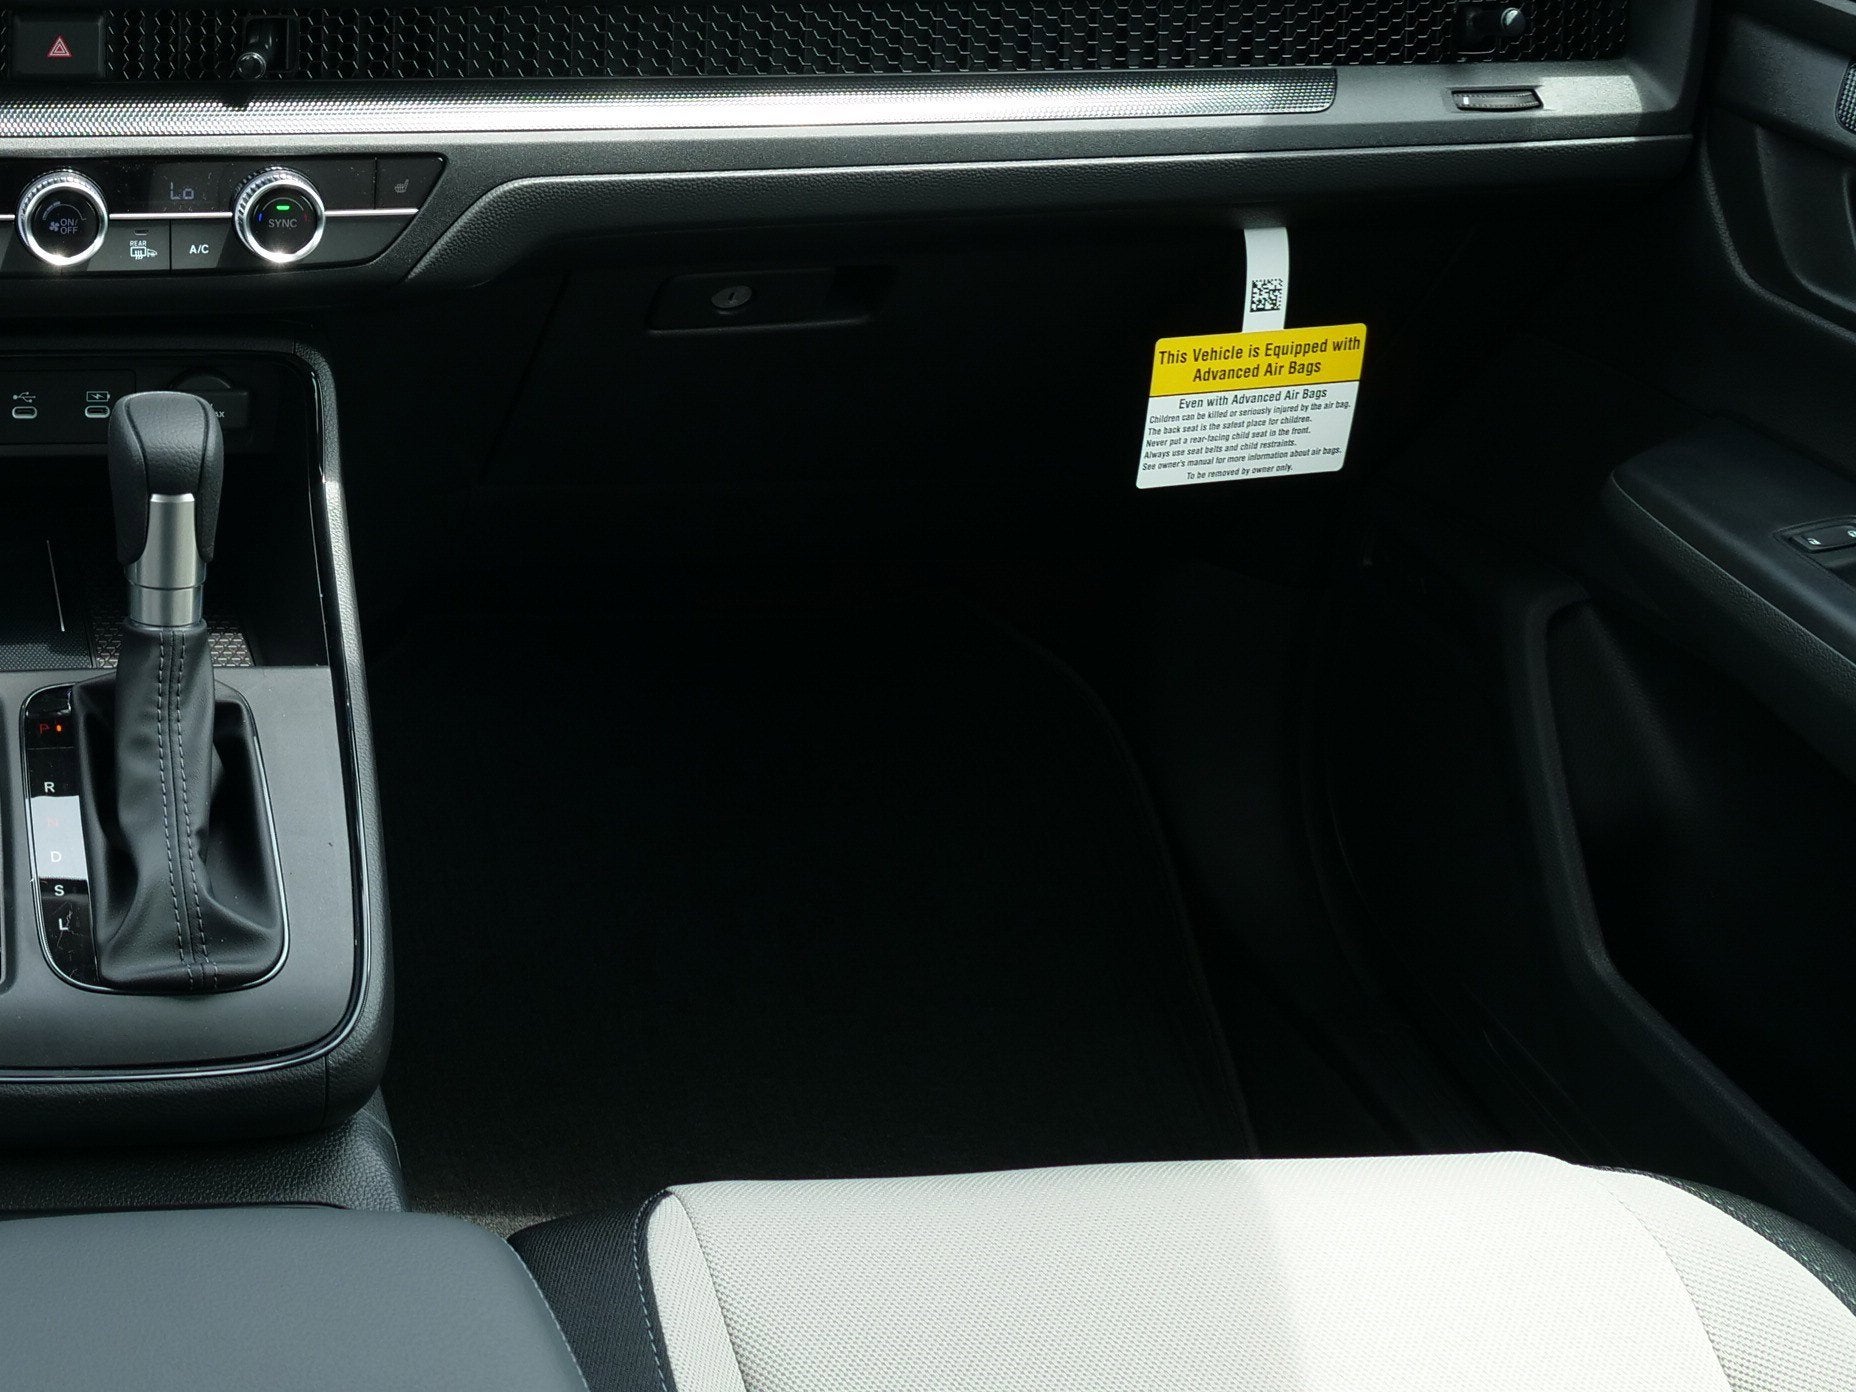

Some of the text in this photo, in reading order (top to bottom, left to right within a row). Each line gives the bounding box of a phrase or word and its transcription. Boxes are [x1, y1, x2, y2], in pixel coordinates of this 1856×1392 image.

[60, 218, 78, 228] ON/
[268, 218, 297, 229] SYNC
[60, 227, 78, 235] OFF
[189, 244, 209, 255] A/C
[1159, 336, 1360, 366] This Vehicle is Equipped with
[1193, 360, 1321, 382] Advanced Air Bags
[1179, 389, 1327, 409] Even with Advanced Air Bags
[1150, 401, 1351, 424] Children killed seriously injured bag.
[1222, 420, 1244, 429] safest
[1247, 419, 1266, 427] place
[1280, 416, 1312, 424] children.
[1146, 439, 1168, 447] Never
[1190, 434, 1230, 443] rear-facing
[1252, 430, 1268, 438] seat
[1292, 427, 1311, 435] front.
[1144, 451, 1170, 459] Always
[1205, 446, 1222, 454] belts
[1240, 442, 1258, 451] child
[1260, 439, 1297, 448] restraints.
[1158, 460, 1185, 469] owner's
[1187, 457, 1214, 466] manual
[1247, 451, 1288, 461] information
[1290, 449, 1310, 457] about
[1322, 447, 1342, 455] bags.
[1208, 468, 1239, 477] removed
[1276, 464, 1293, 472] only.
[45, 782, 55, 793] R
[50, 851, 62, 863] D
[54, 884, 65, 897] S
[58, 918, 69, 931] L
